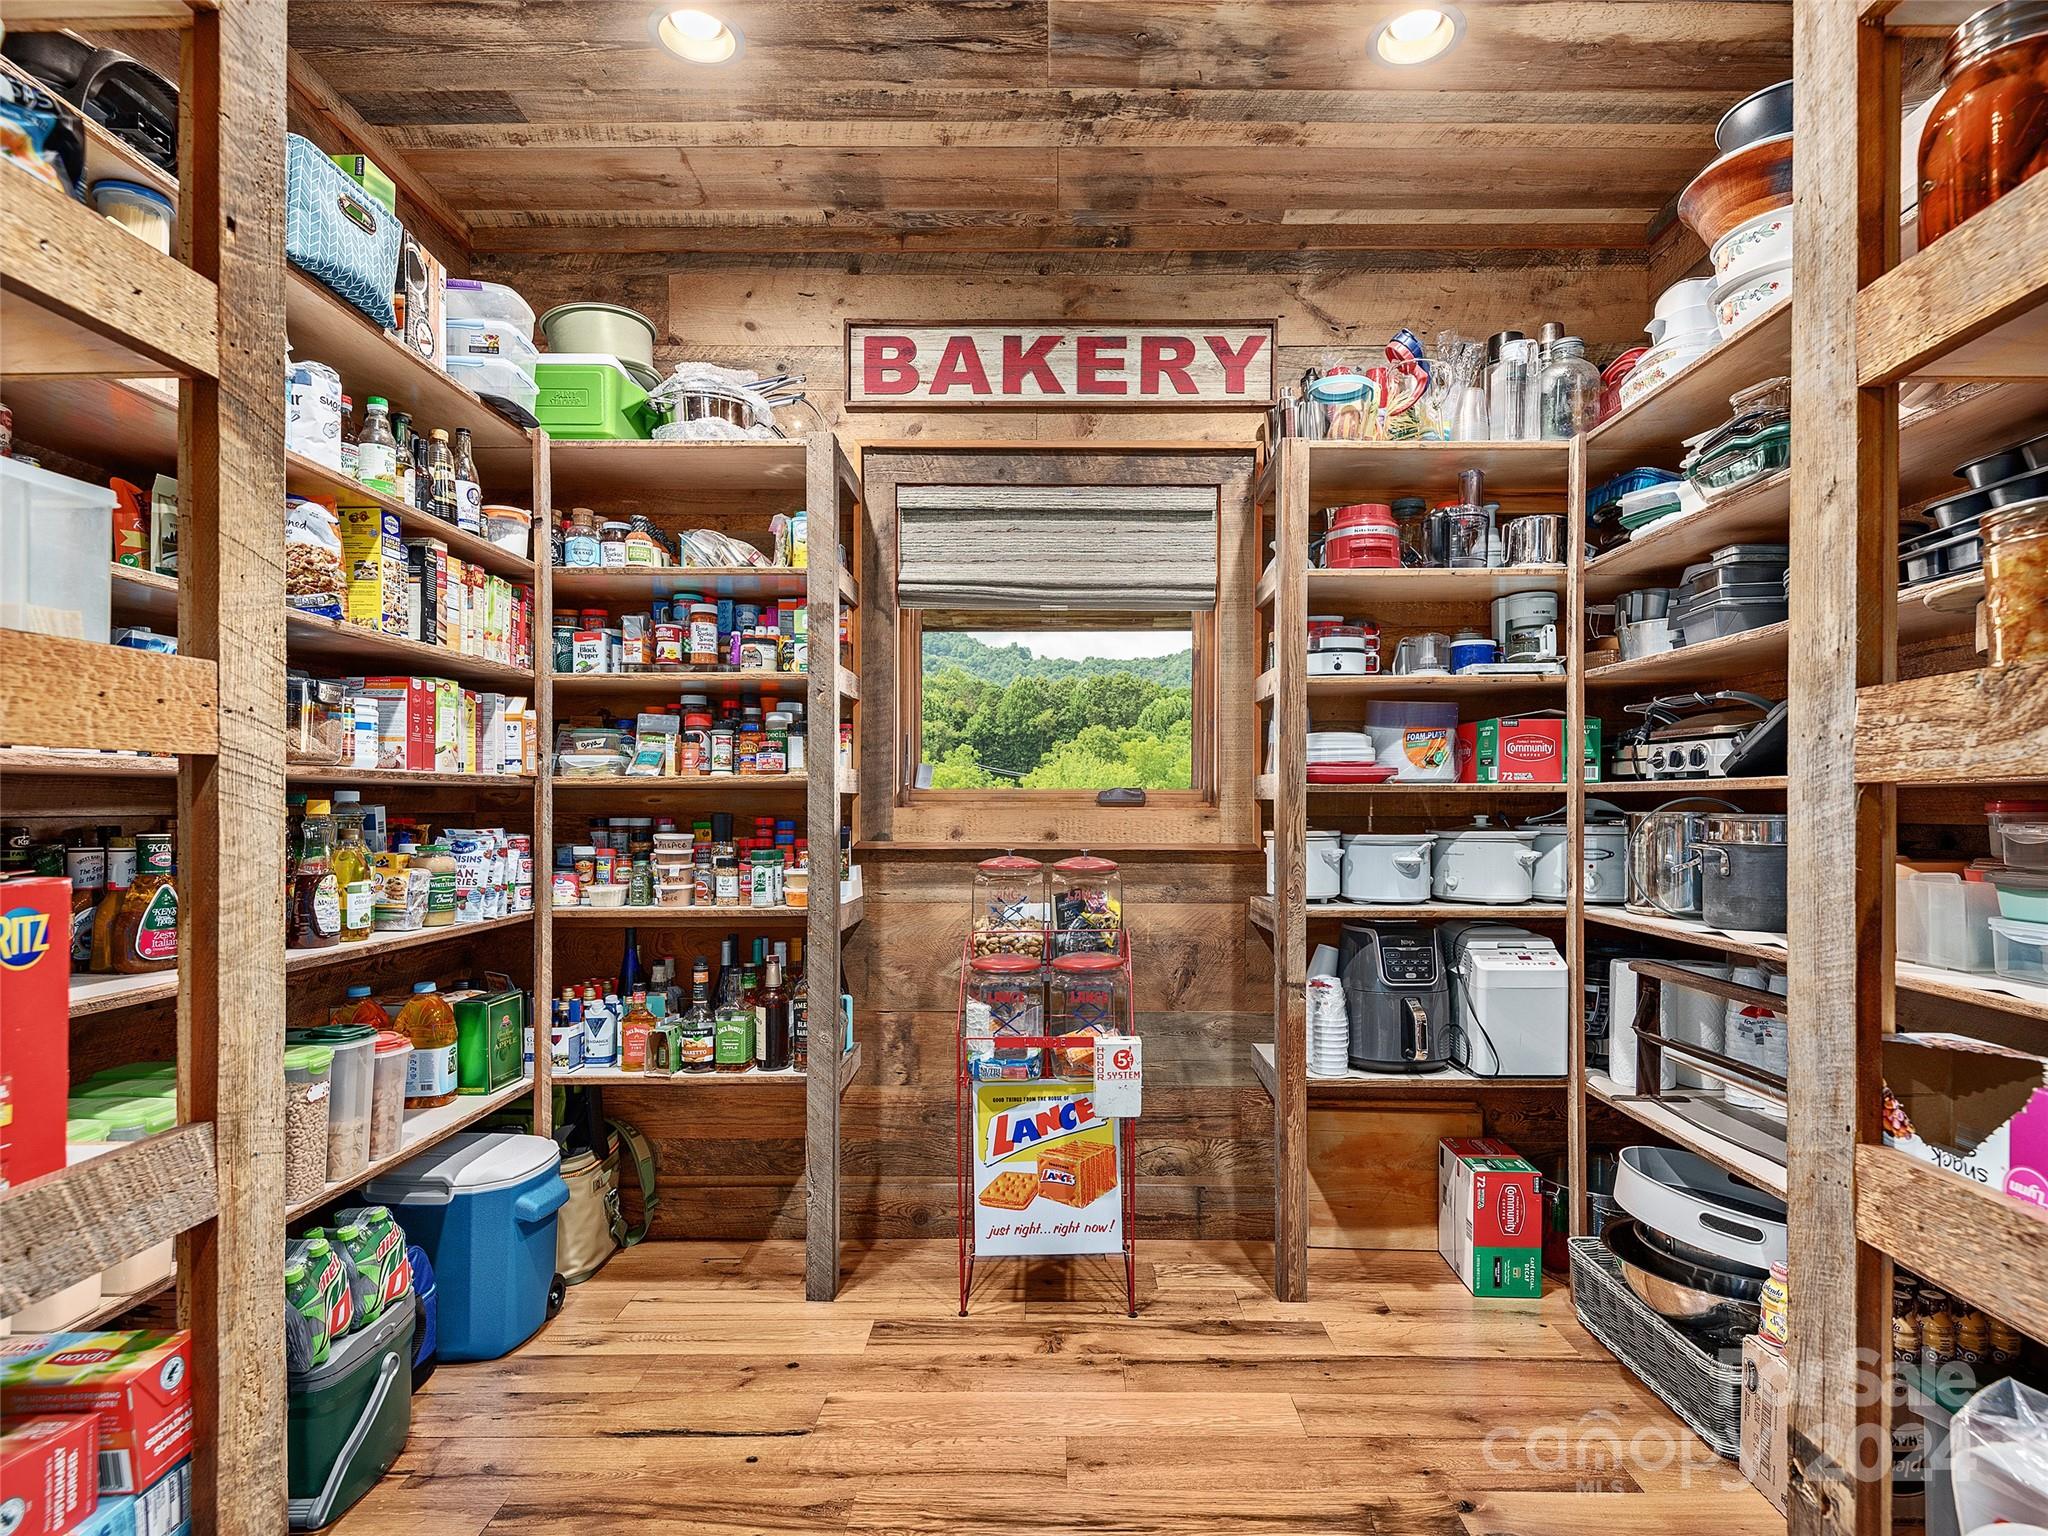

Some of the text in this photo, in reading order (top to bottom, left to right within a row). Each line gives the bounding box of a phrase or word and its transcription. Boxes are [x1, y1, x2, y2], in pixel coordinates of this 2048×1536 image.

[863, 335, 1267, 394] BAKERY
[319, 395, 341, 412] sug
[580, 645, 597, 653] Black
[577, 652, 599, 661] Pepper
[1406, 732, 1426, 741] FOAM
[1506, 742, 1553, 755] Community
[1502, 772, 1513, 780] 72
[147, 844, 172, 853] KEN
[80, 868, 91, 876] The
[152, 907, 177, 916] KEN'S
[0, 913, 51, 960] RITZ
[154, 932, 176, 940] Zesty
[152, 939, 178, 948] Italian
[794, 1002, 808, 1010] JAME
[728, 1024, 745, 1035] DANIEL'S
[494, 1037, 518, 1050] APPLE
[1097, 1047, 1105, 1081] HONOR
[1107, 1071, 1141, 1080] SYSTEM
[992, 1097, 1096, 1157] LANCE
[1932, 1148, 1988, 1183] snack
[1042, 1170, 1072, 1183] LANCE
[1476, 1176, 1486, 1188] 72
[1505, 1186, 1516, 1234] Community
[986, 1224, 1010, 1240] just
[1084, 1219, 1116, 1234] now!
[376, 1224, 400, 1263] diet
[318, 1254, 342, 1291] diet
[55, 1351, 112, 1363] Lipton
[66, 1448, 79, 1512] SOURCED.
[53, 1446, 66, 1532] SUSTAINABLY
